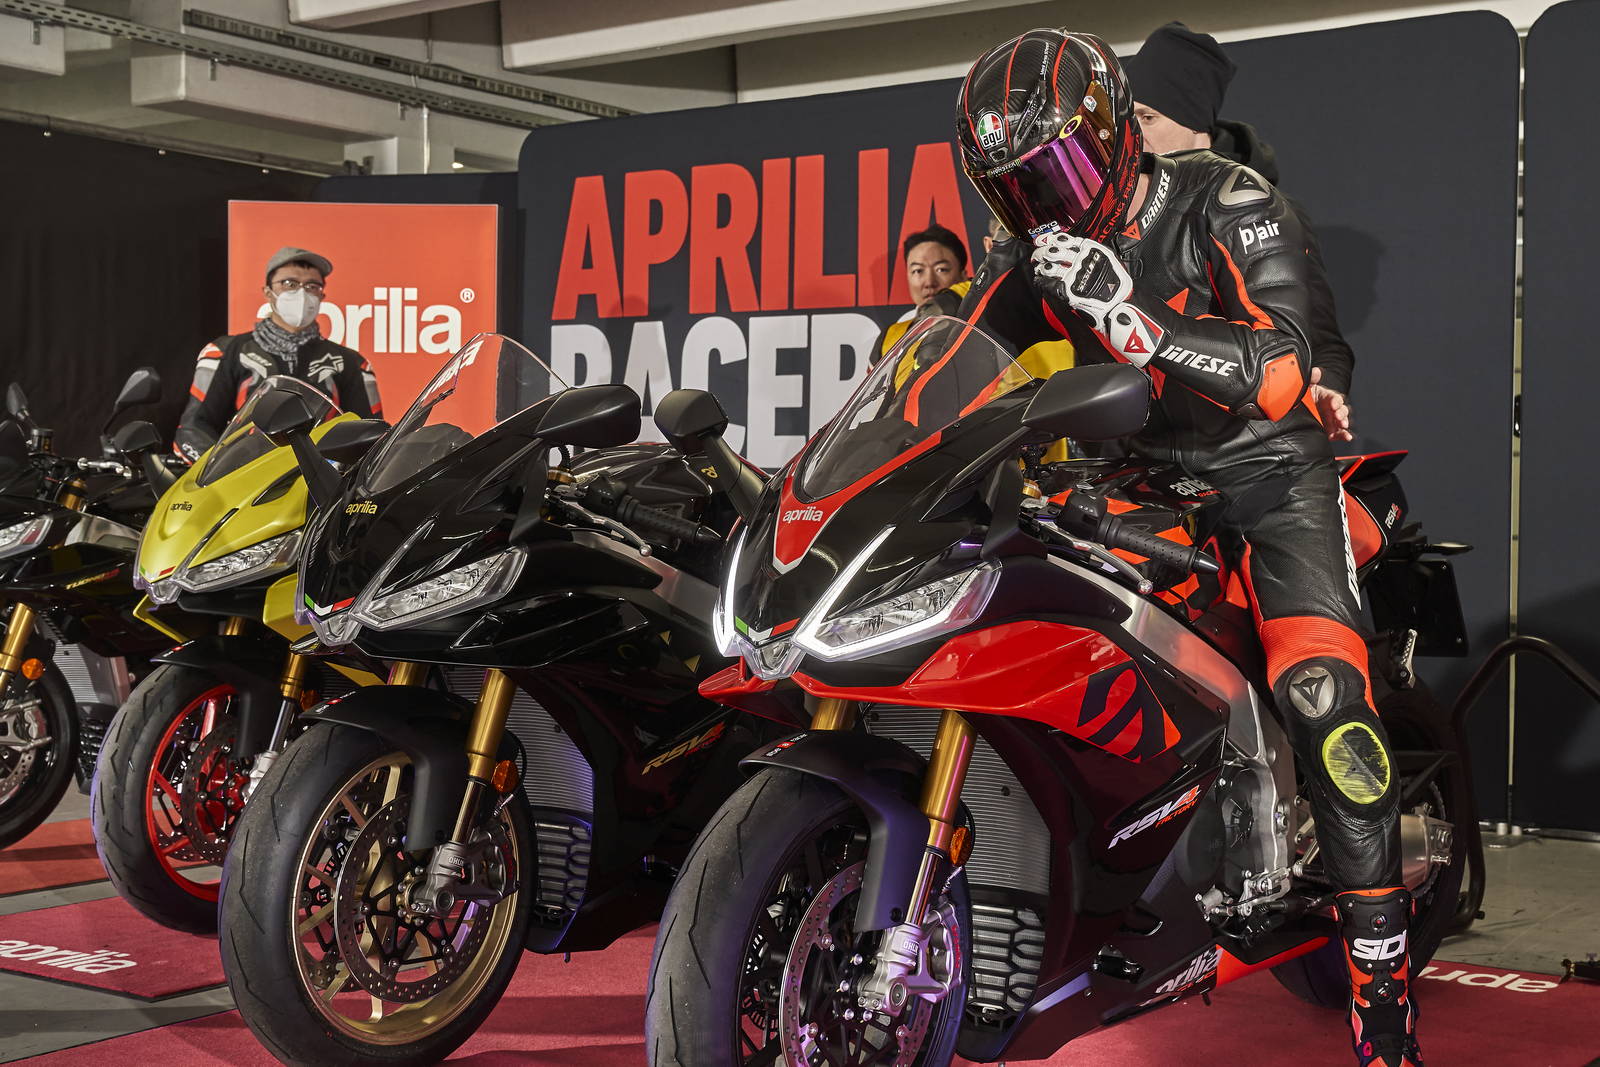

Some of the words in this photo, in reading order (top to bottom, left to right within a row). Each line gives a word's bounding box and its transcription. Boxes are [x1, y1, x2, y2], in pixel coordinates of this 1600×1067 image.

[551, 142, 975, 320] APRILIA
[1027, 220, 1059, 236] GoPro
[1097, 199, 1126, 244] ACING
[256, 287, 463, 354] rilia
[1158, 344, 1240, 377] INESE
[548, 312, 918, 470] RACER
[170, 501, 193, 512] aprilia
[345, 500, 379, 516] aprilia
[782, 505, 824, 525] aprilia
[1107, 784, 1202, 850] RSV4
